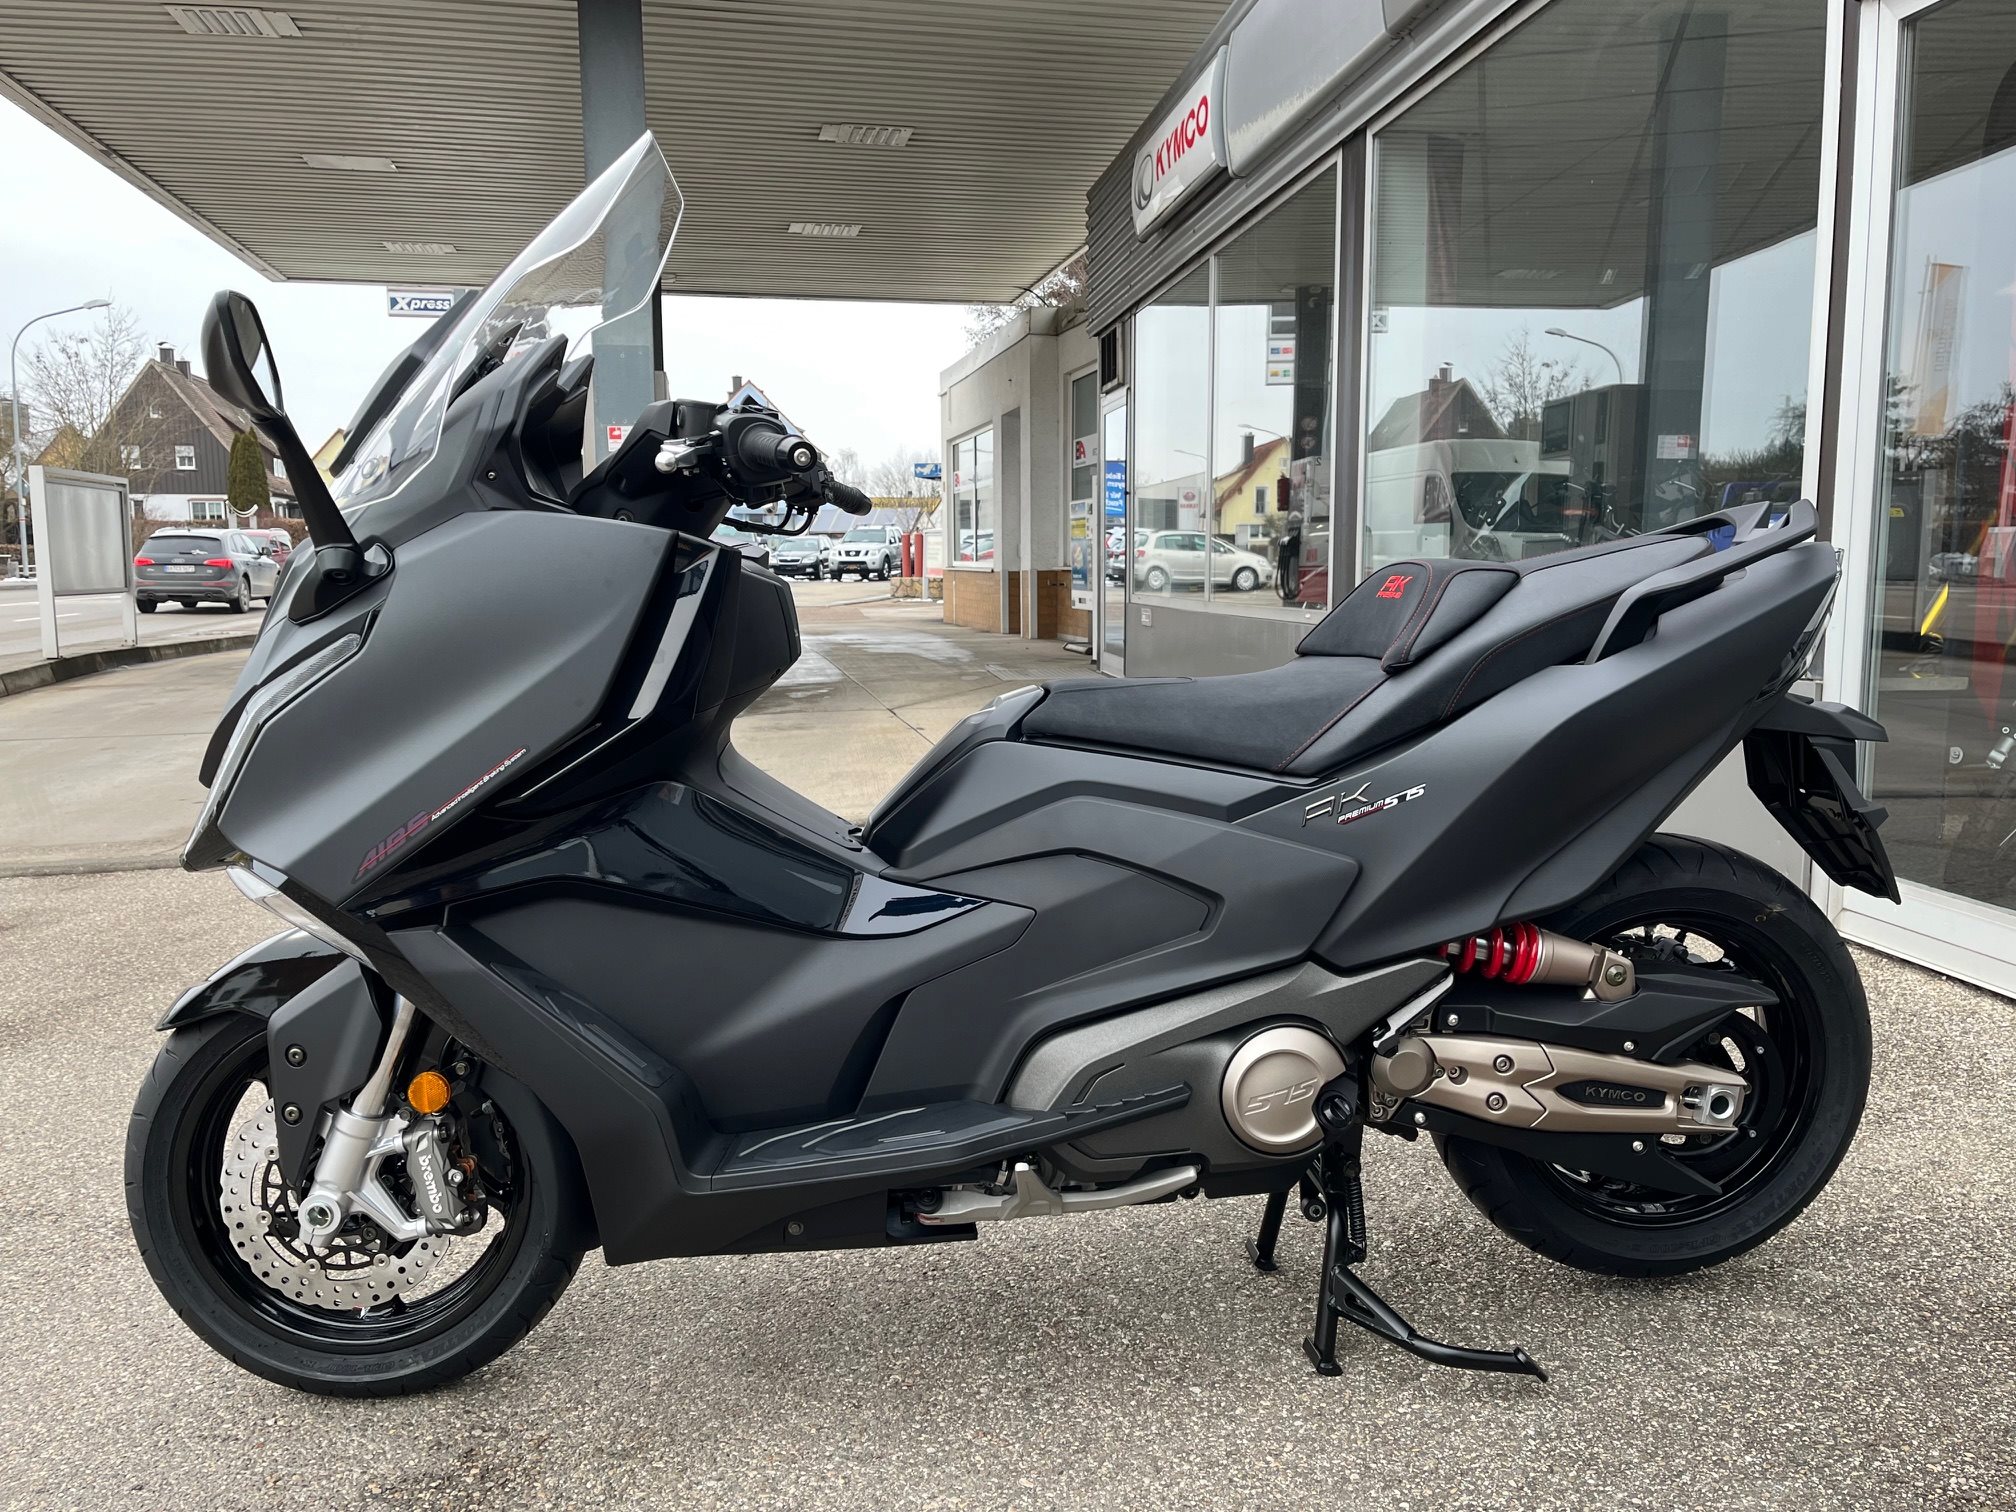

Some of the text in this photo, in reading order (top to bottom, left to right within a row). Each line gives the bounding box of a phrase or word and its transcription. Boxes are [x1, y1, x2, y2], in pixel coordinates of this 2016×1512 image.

[1156, 95, 1208, 181] KYMCO
[391, 296, 450, 311] Xpress
[1380, 575, 1413, 592] AK
[1301, 781, 1372, 827] AK
[1338, 783, 1427, 824] PREMIUM 575
[1244, 1077, 1319, 1116] 575
[1585, 1085, 1647, 1103] KYMCO
[418, 1154, 443, 1214] brembo
